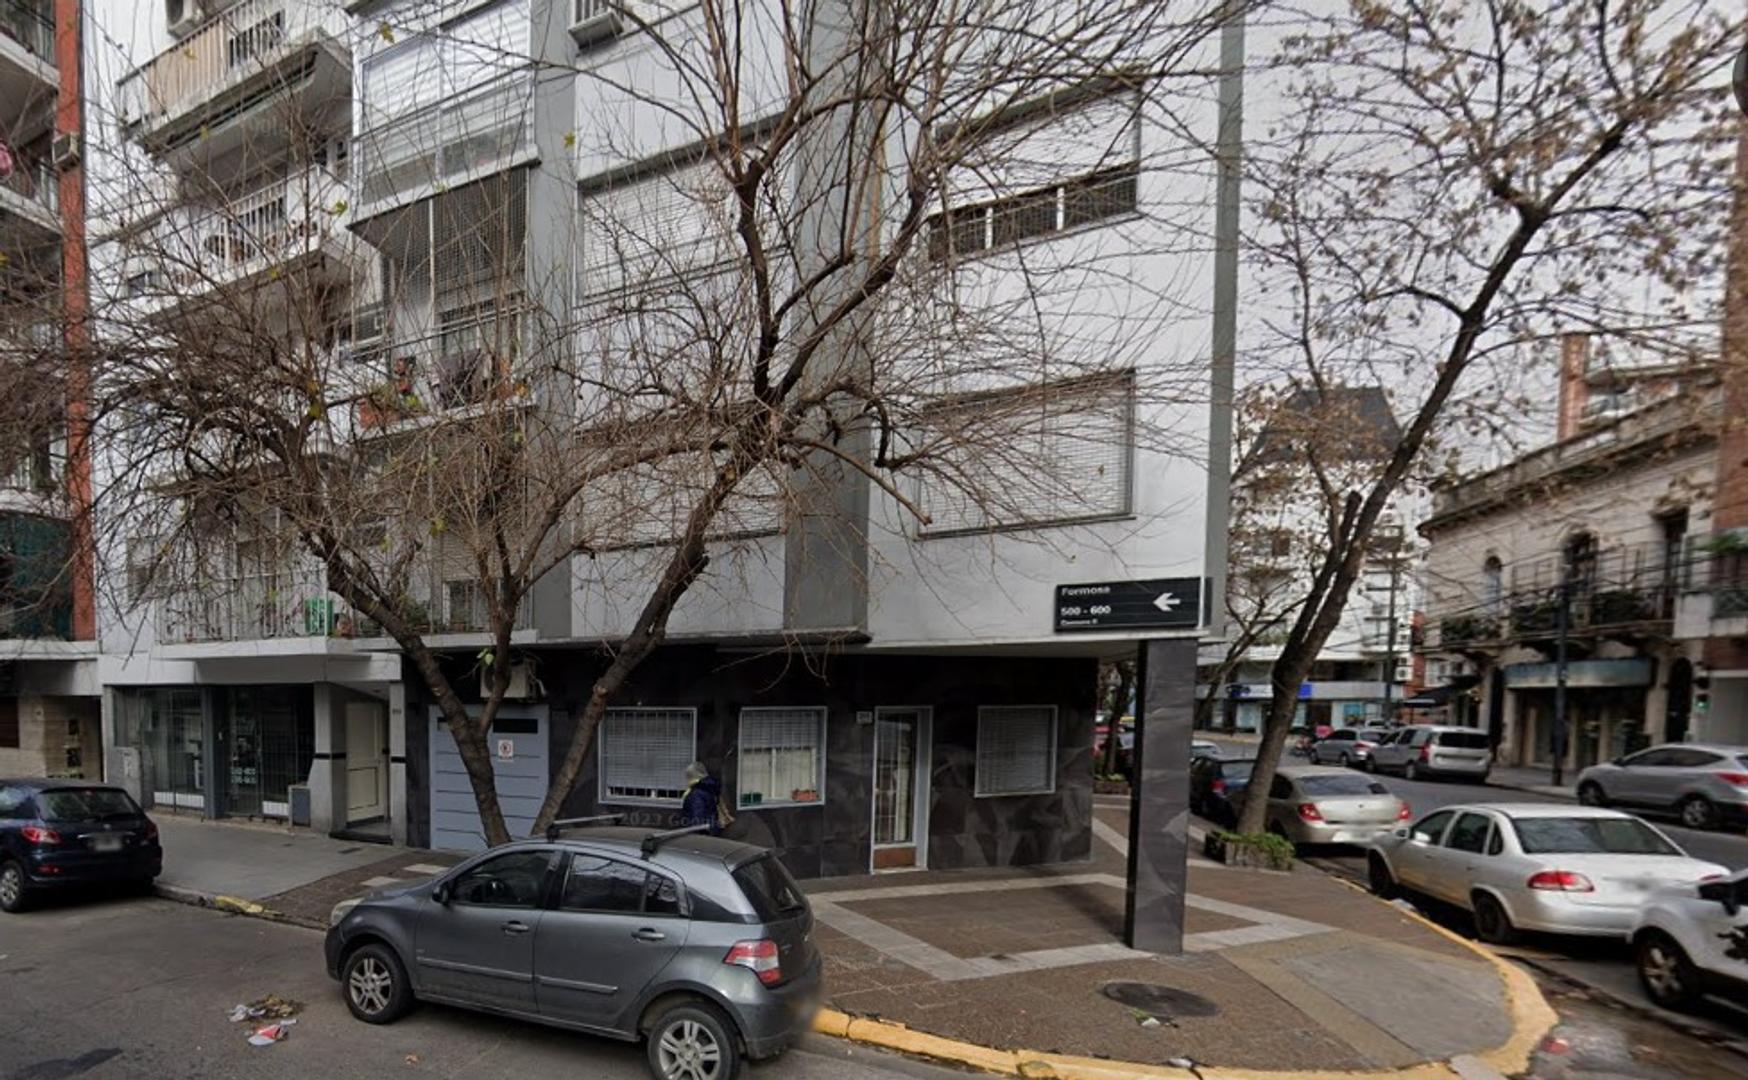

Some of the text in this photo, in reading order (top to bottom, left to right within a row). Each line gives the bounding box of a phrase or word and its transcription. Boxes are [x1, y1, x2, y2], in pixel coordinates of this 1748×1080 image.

[1061, 586, 1111, 596] Formosa
[1060, 606, 1081, 616] 500
[1090, 605, 1111, 615] 600
